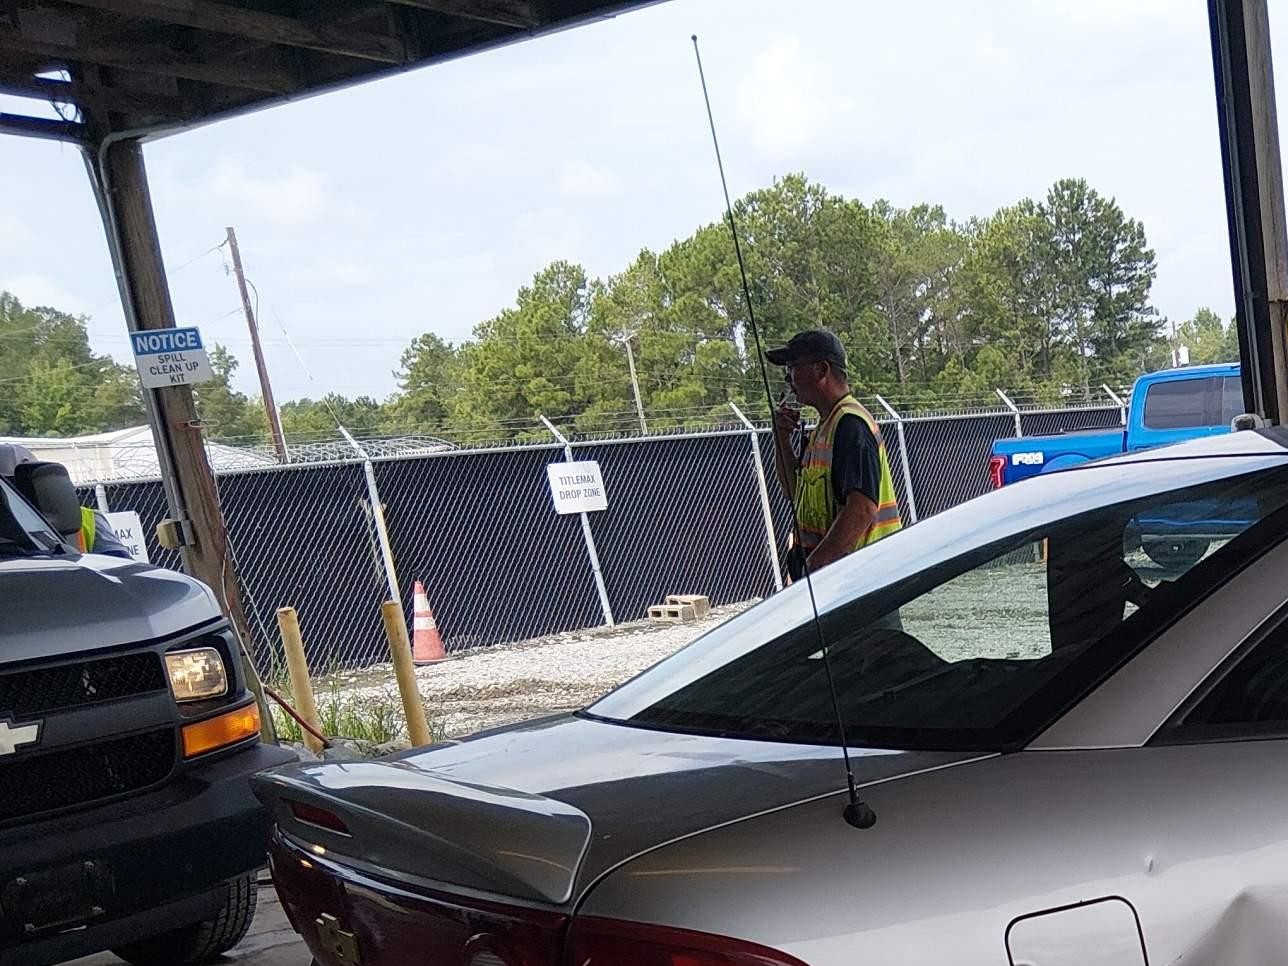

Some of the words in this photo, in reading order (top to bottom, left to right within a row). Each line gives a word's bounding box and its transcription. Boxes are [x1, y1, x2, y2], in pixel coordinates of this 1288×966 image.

[136, 331, 197, 352] NOTICE
[158, 352, 186, 364] SPILL
[150, 364, 183, 376] CLEAN
[185, 361, 199, 371] UP
[169, 373, 185, 384] KIT
[559, 475, 595, 485] TITLEMAX
[559, 489, 582, 500] DROP
[583, 487, 601, 498] ZONE
